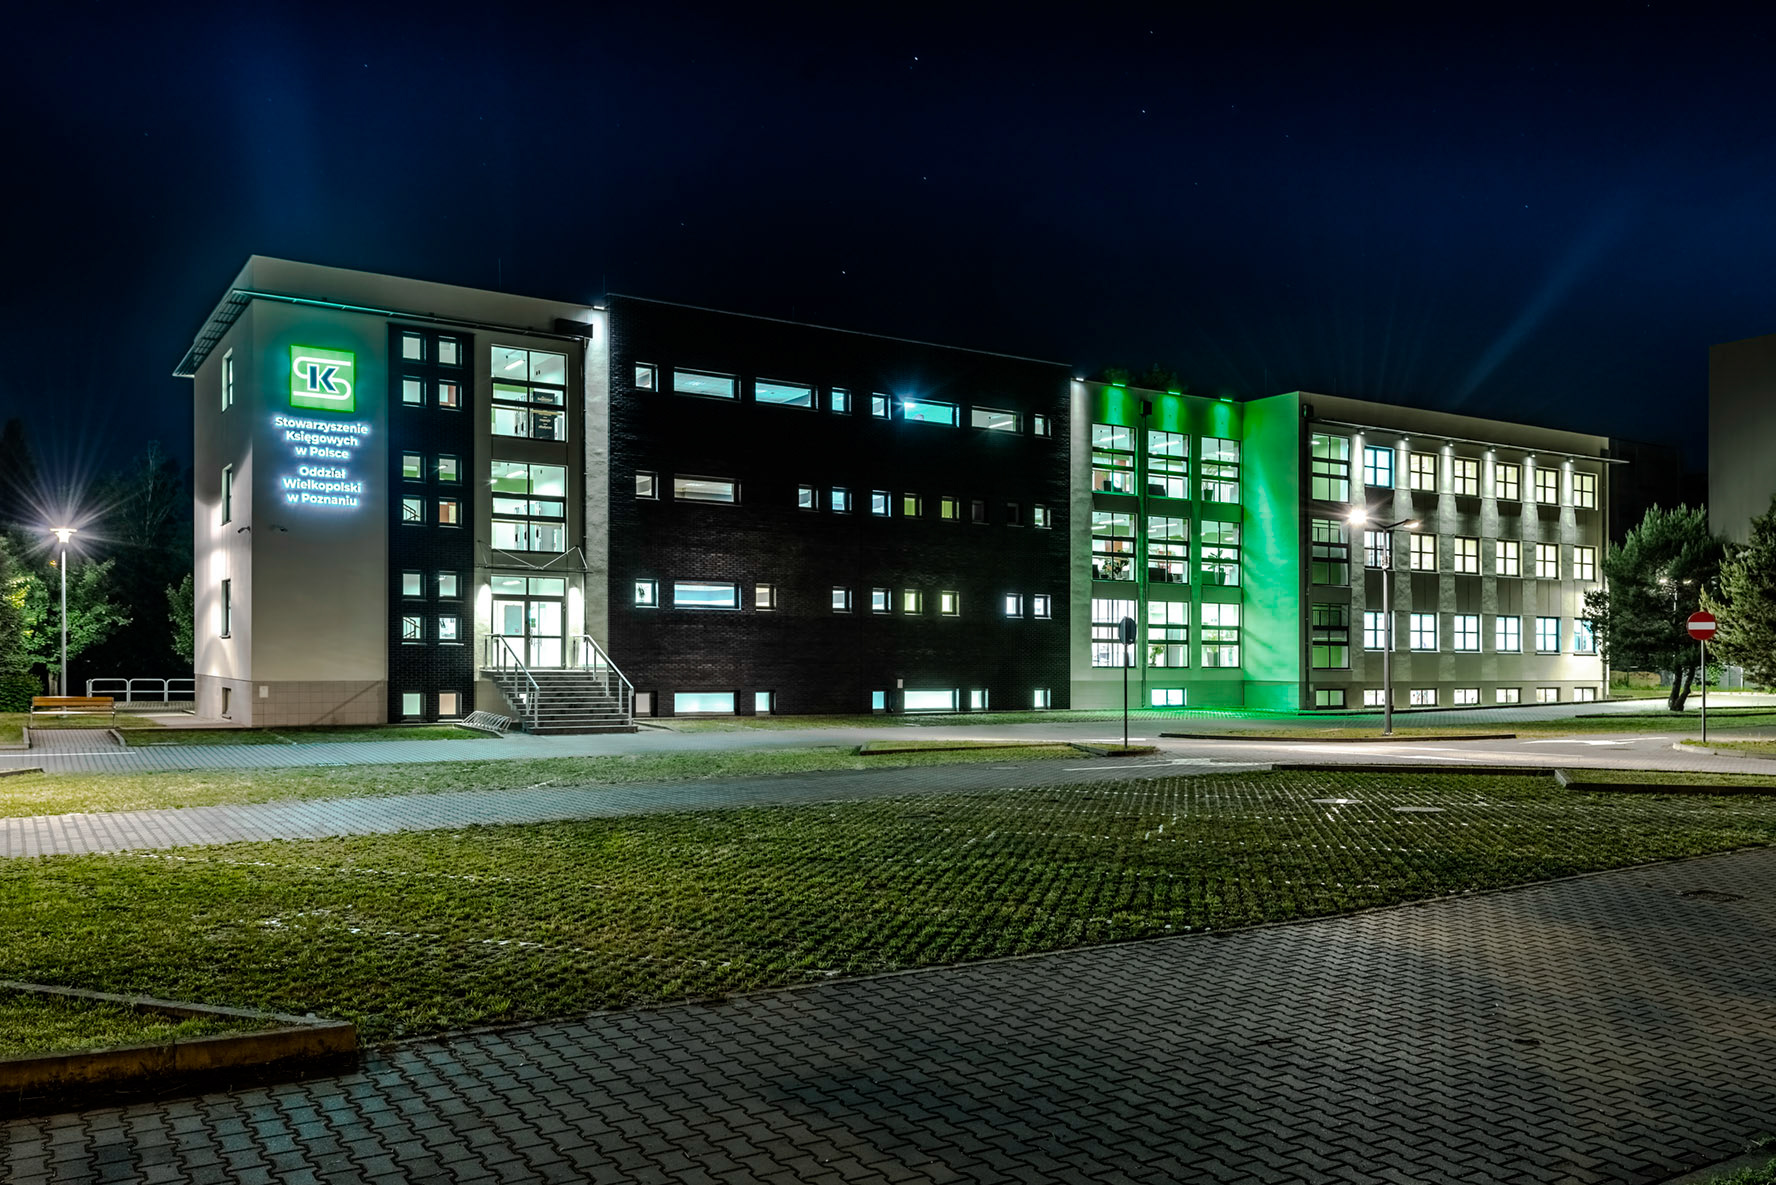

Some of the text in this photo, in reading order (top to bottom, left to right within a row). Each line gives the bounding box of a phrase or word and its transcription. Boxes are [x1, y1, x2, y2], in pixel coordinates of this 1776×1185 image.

[275, 416, 369, 435] Stowarzyszenie
[285, 430, 359, 446] Księgowych
[295, 446, 349, 459] w Polsce
[299, 466, 346, 479] Oddział
[282, 478, 362, 493] Wielkopolski
[286, 493, 358, 506] w Poznaniu
